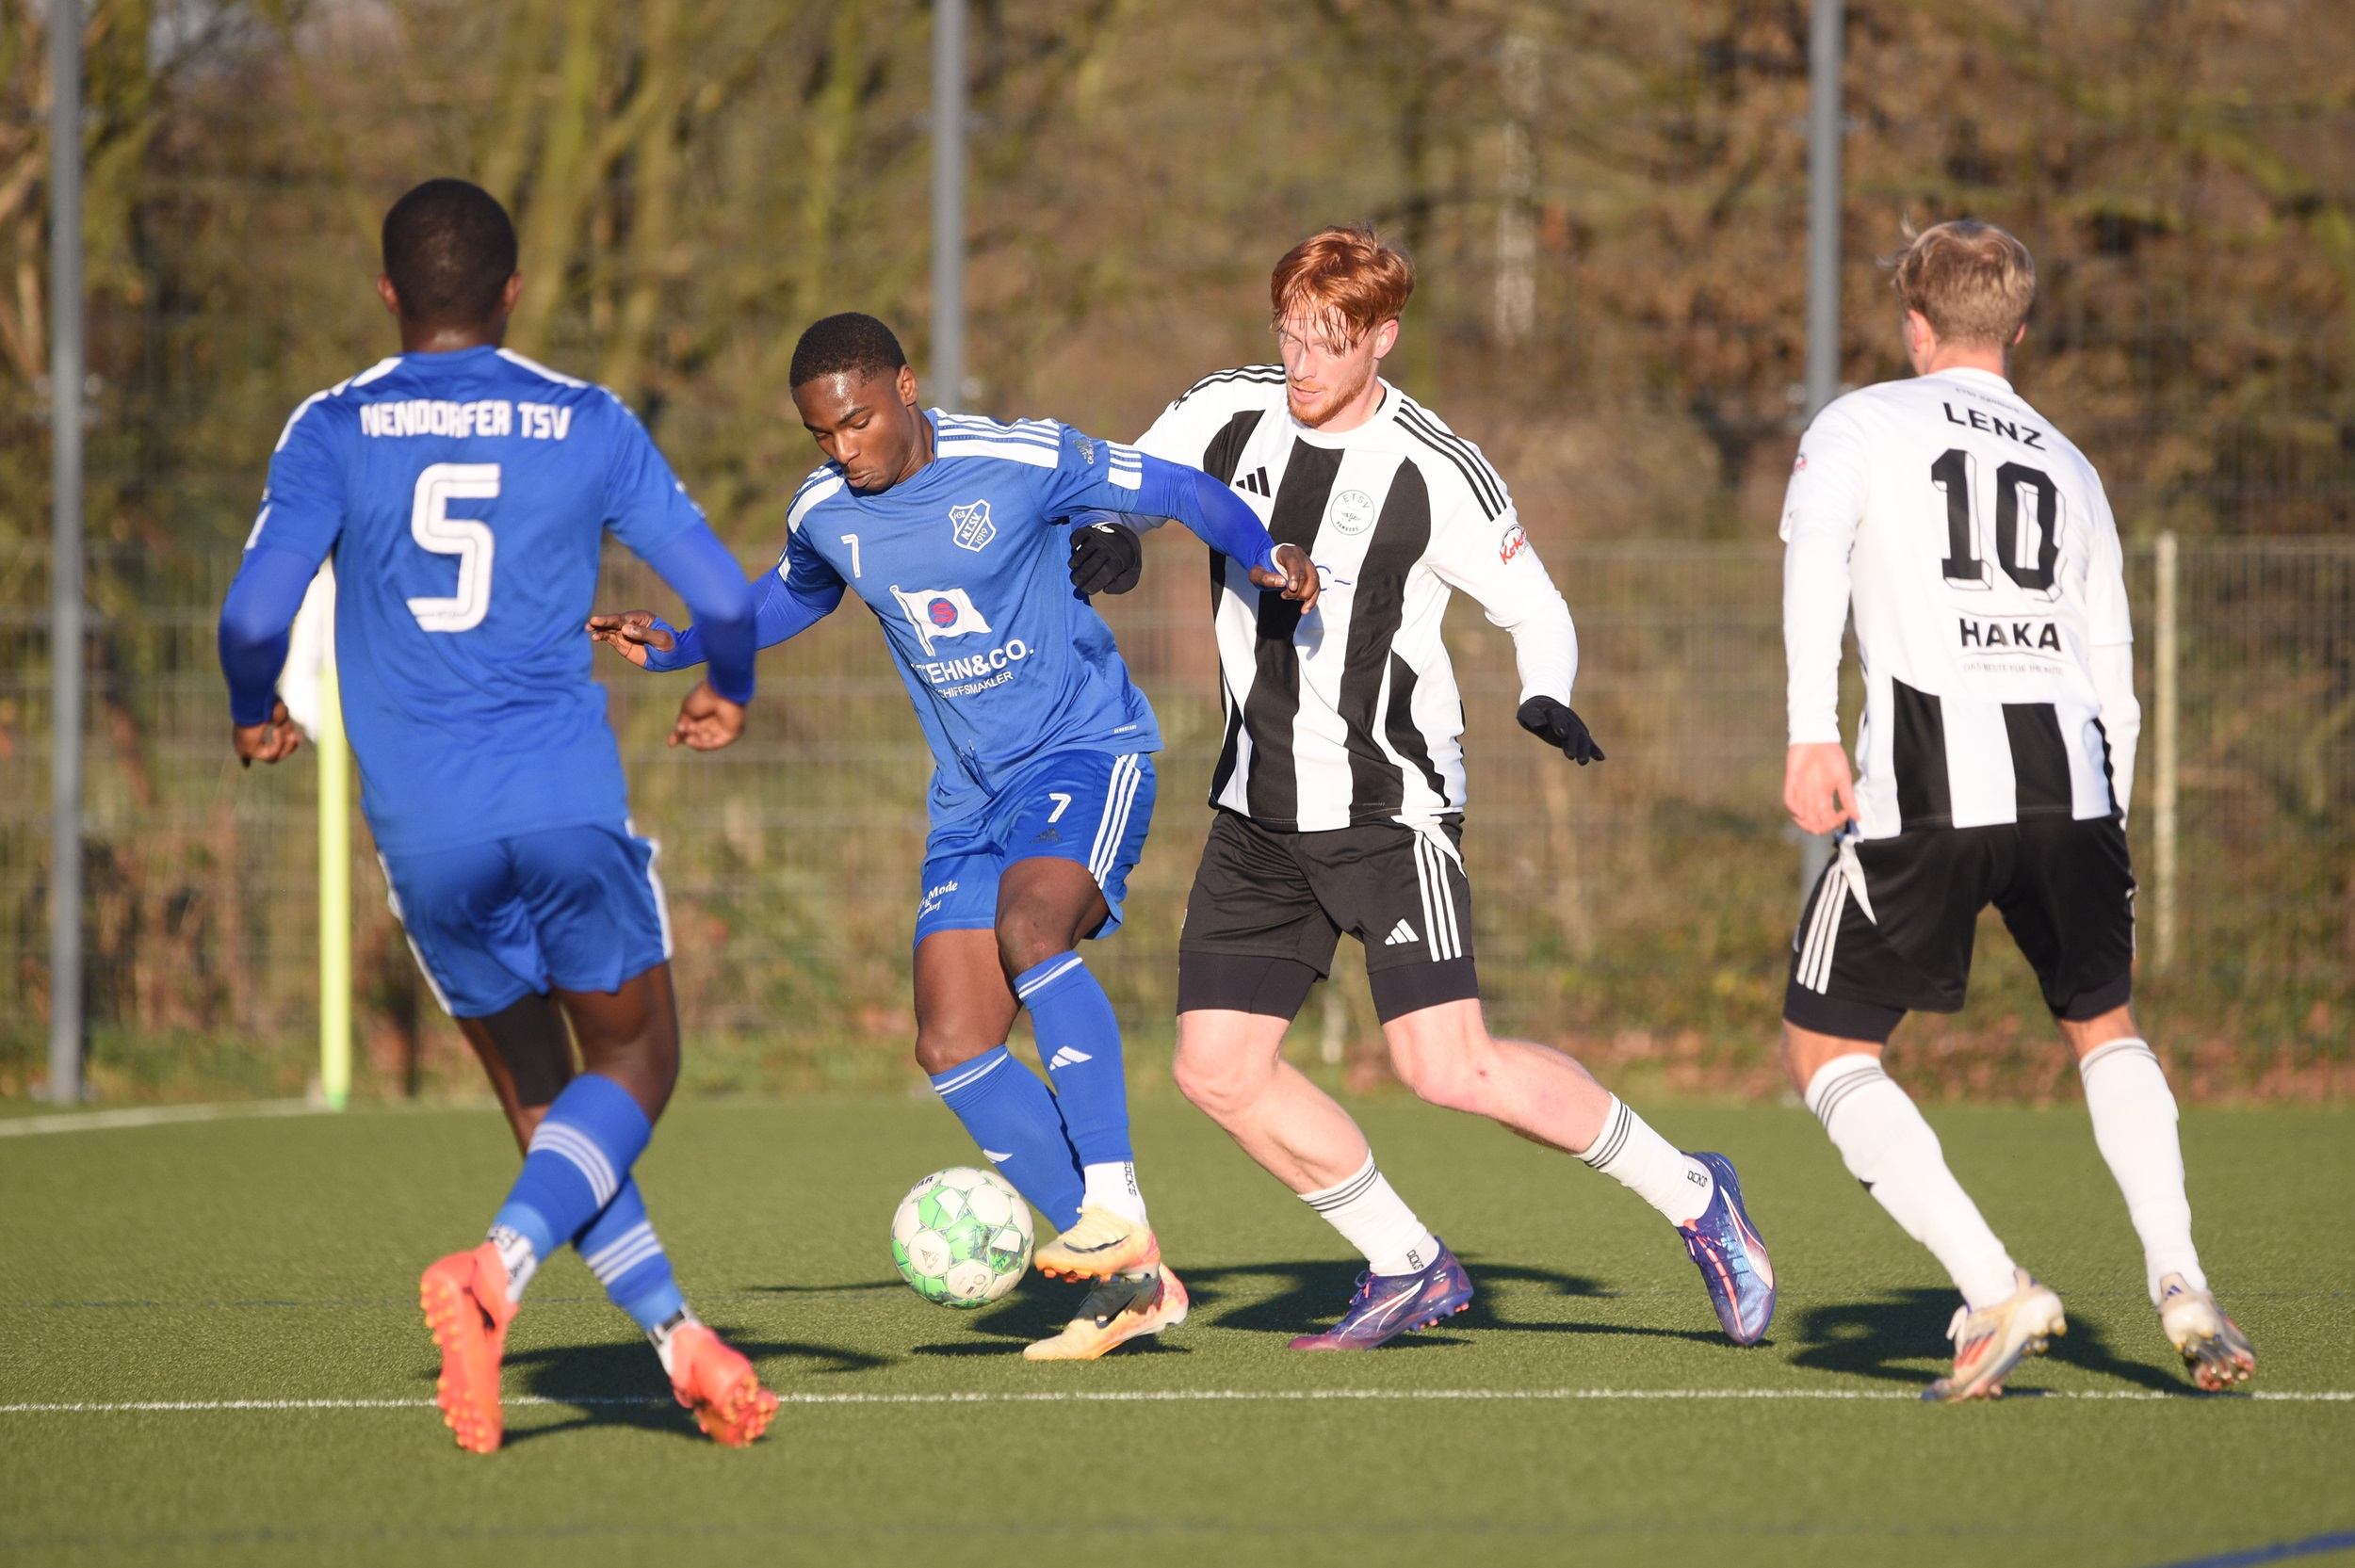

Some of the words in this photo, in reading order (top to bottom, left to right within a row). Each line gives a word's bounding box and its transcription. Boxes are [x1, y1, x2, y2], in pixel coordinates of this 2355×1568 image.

[517, 401, 572, 440] TSV
[1942, 401, 2046, 451] LENZ
[953, 510, 966, 520] HSB
[1931, 448, 2068, 604] 10
[406, 461, 502, 633] 5
[974, 527, 989, 545] 1919
[840, 533, 862, 578] 7
[1959, 617, 2061, 653] HAKA
[911, 639, 1034, 685] TEHN&CO.
[935, 671, 1015, 699] CHIFFSMAKLER
[1048, 793, 1072, 823] 7
[928, 880, 958, 900] Mode
